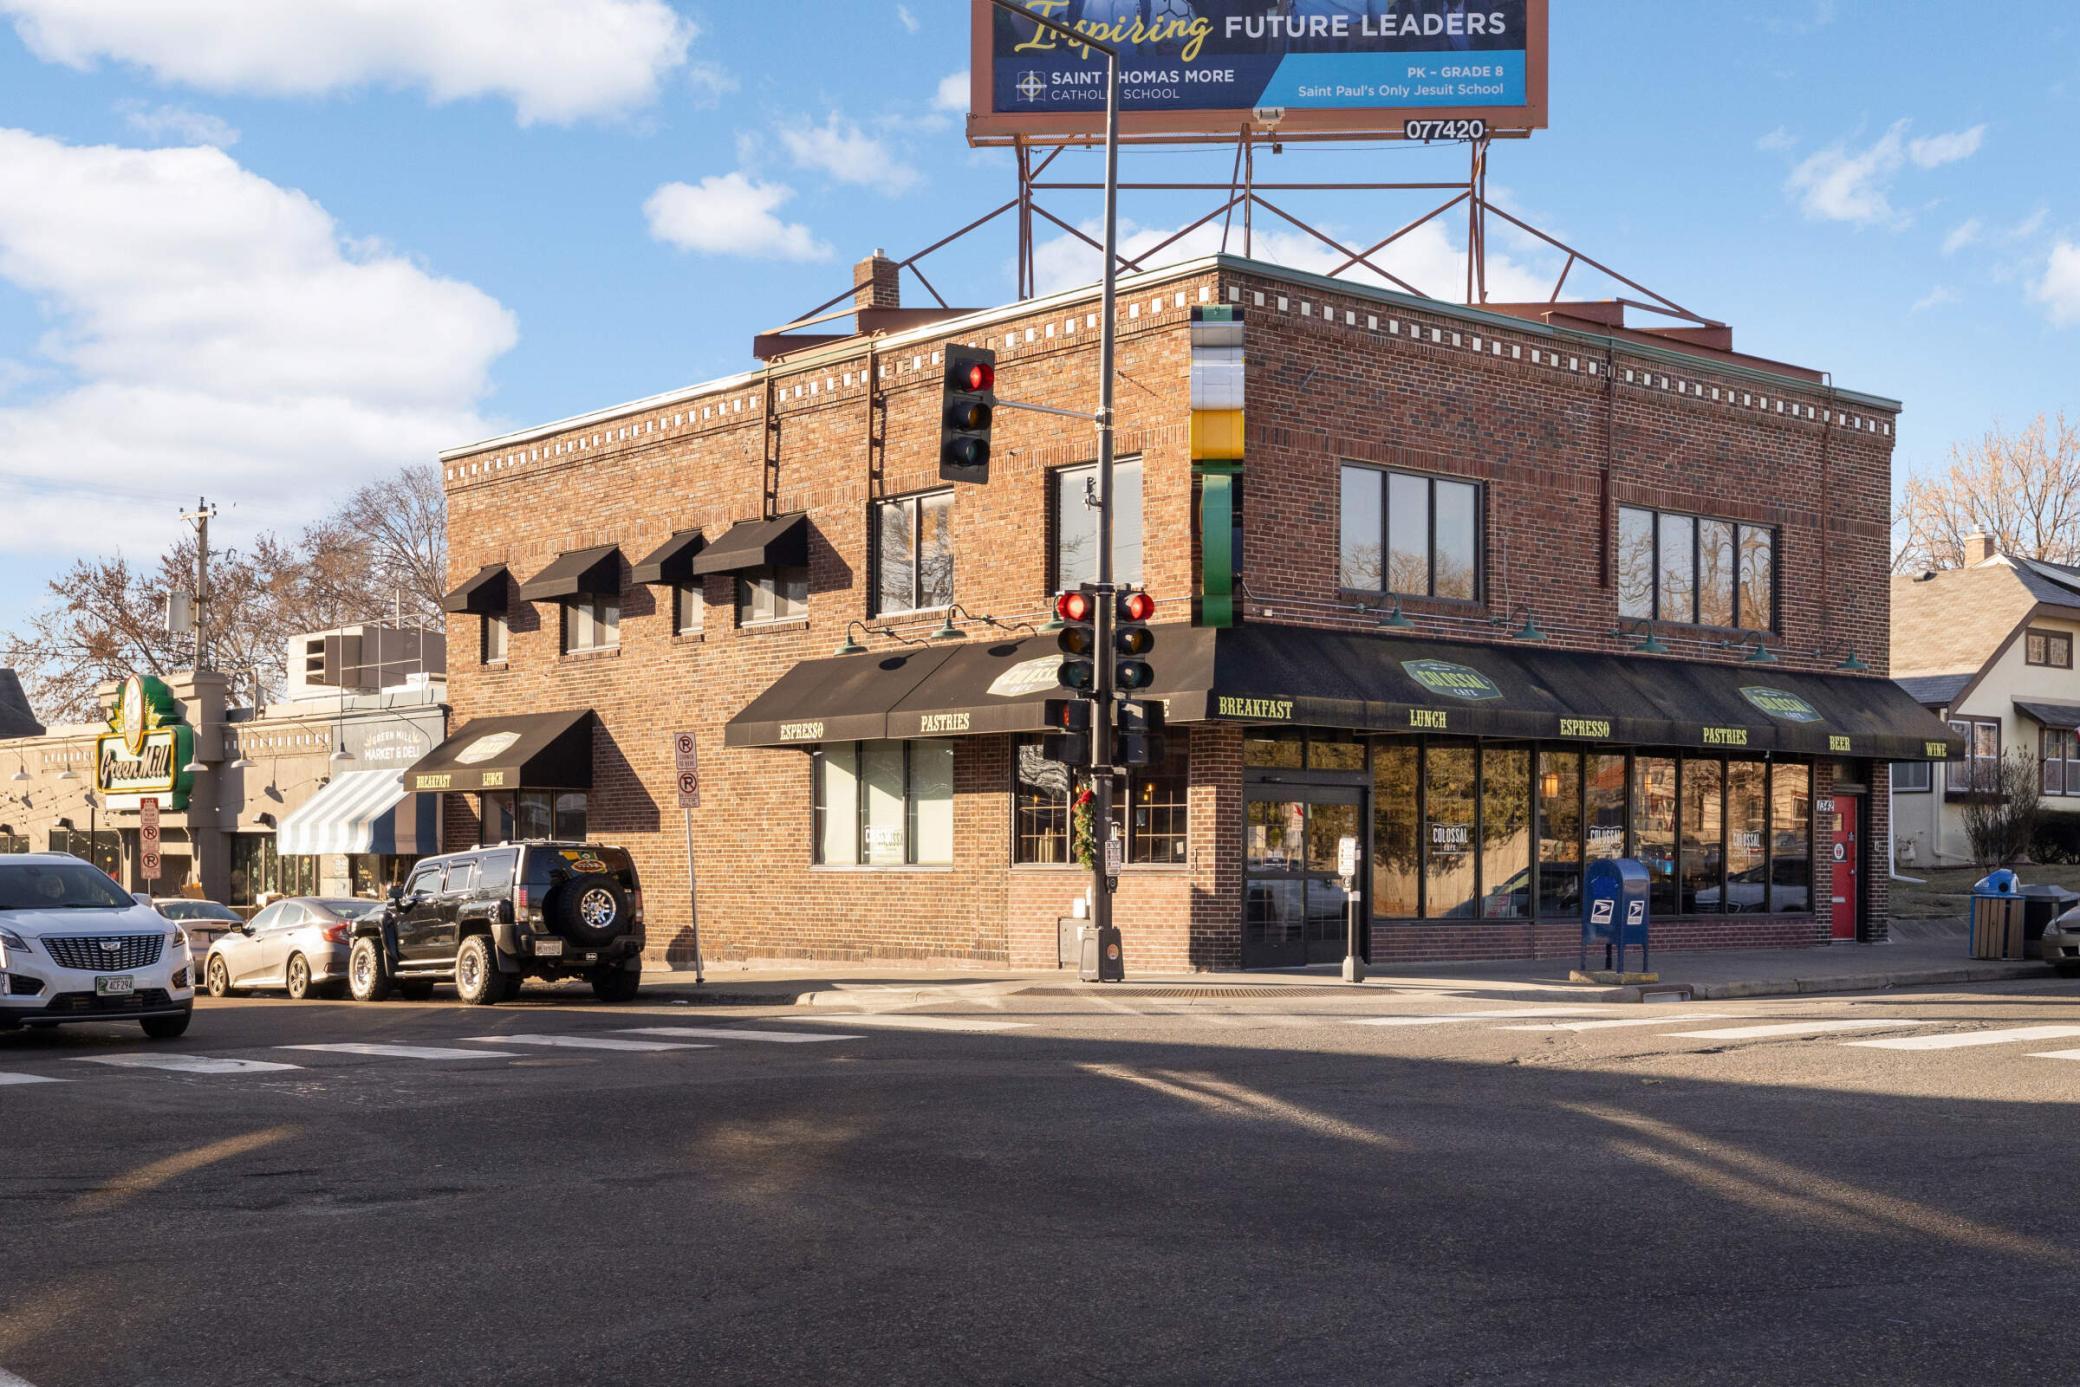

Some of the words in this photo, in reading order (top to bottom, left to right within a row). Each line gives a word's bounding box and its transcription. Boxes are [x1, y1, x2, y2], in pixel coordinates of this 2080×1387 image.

[1014, 0, 1213, 62] Inspiring
[1225, 15, 1349, 39] FUTURE
[1362, 12, 1506, 36] LEADERS
[1051, 71, 1102, 85] SAINT
[1107, 70, 1180, 84] HOMAS
[1185, 69, 1235, 83] MORE
[1407, 67, 1426, 78] PK
[1441, 66, 1491, 78] GRADE
[1495, 66, 1504, 77] 8
[1051, 89, 1107, 101] CATHOL
[1124, 88, 1180, 100] SCHOOL
[1298, 85, 1332, 97] Saint
[1336, 84, 1375, 97] Paul's
[1382, 84, 1409, 98] Only
[1414, 83, 1453, 96] Jesuit
[1458, 83, 1504, 95] School
[1407, 120, 1484, 139] 077420
[1219, 696, 1293, 719] BREAKFAST
[920, 713, 970, 732] PASTRIES
[1410, 709, 1447, 728] LUNCH
[780, 722, 824, 740] ESPRESSO
[1560, 719, 1610, 737] ESPRESSO
[1703, 727, 1747, 745] PASTRIES
[1829, 735, 1851, 751] BEER
[1925, 742, 1947, 757] WINE
[365, 747, 395, 760] MARKET
[403, 746, 420, 758] DELI
[100, 749, 139, 790] Green
[139, 745, 171, 779] Mill
[416, 774, 452, 789] BREAKFAST
[482, 772, 504, 786] LUNCH
[1433, 828, 1468, 843] COLOSSAL
